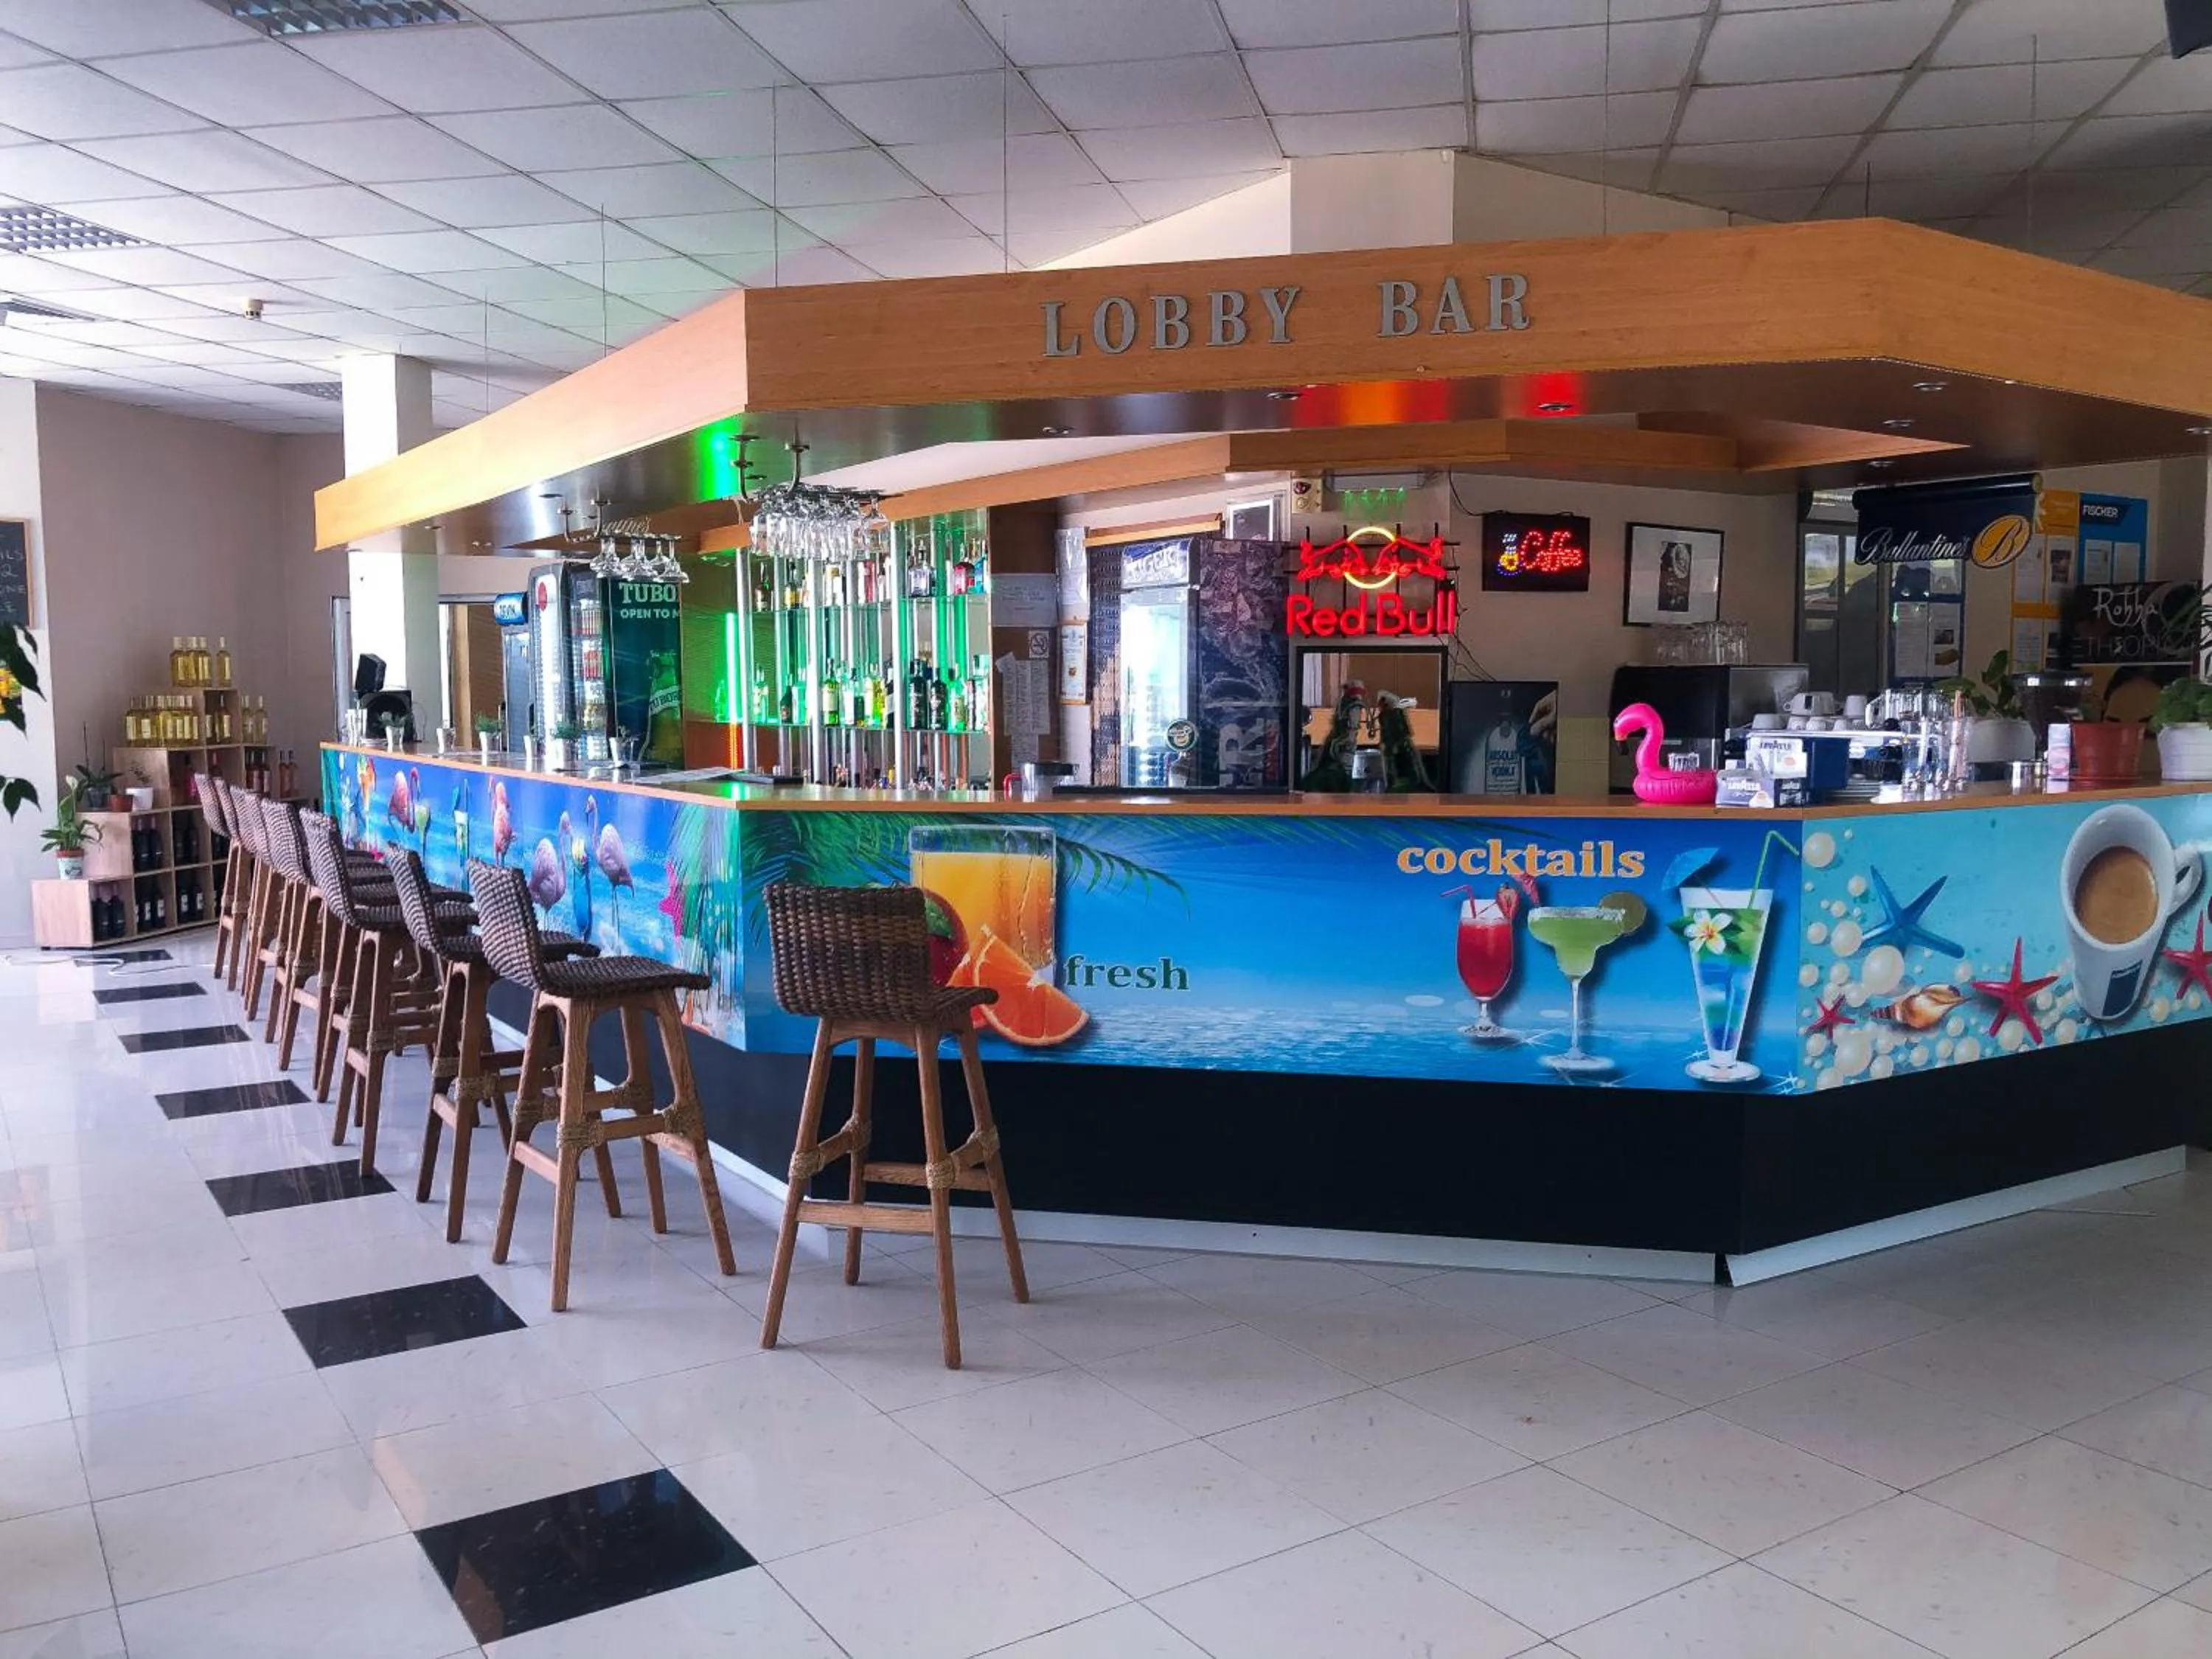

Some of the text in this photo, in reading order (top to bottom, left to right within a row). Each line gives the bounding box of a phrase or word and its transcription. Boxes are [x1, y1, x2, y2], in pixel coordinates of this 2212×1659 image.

[1040, 274, 1531, 358] LOBBY BAR
[2082, 504, 2119, 518] FISCHER
[1520, 530, 1582, 571] Coffee
[1857, 527, 1971, 564] Ballantine's
[619, 582, 679, 604] TUBO
[620, 608, 652, 619] OPEN
[653, 608, 670, 619] TO
[1286, 589, 1456, 636] Red Bull
[1397, 838, 1646, 878] cocktails
[1065, 954, 1190, 990] fresh
